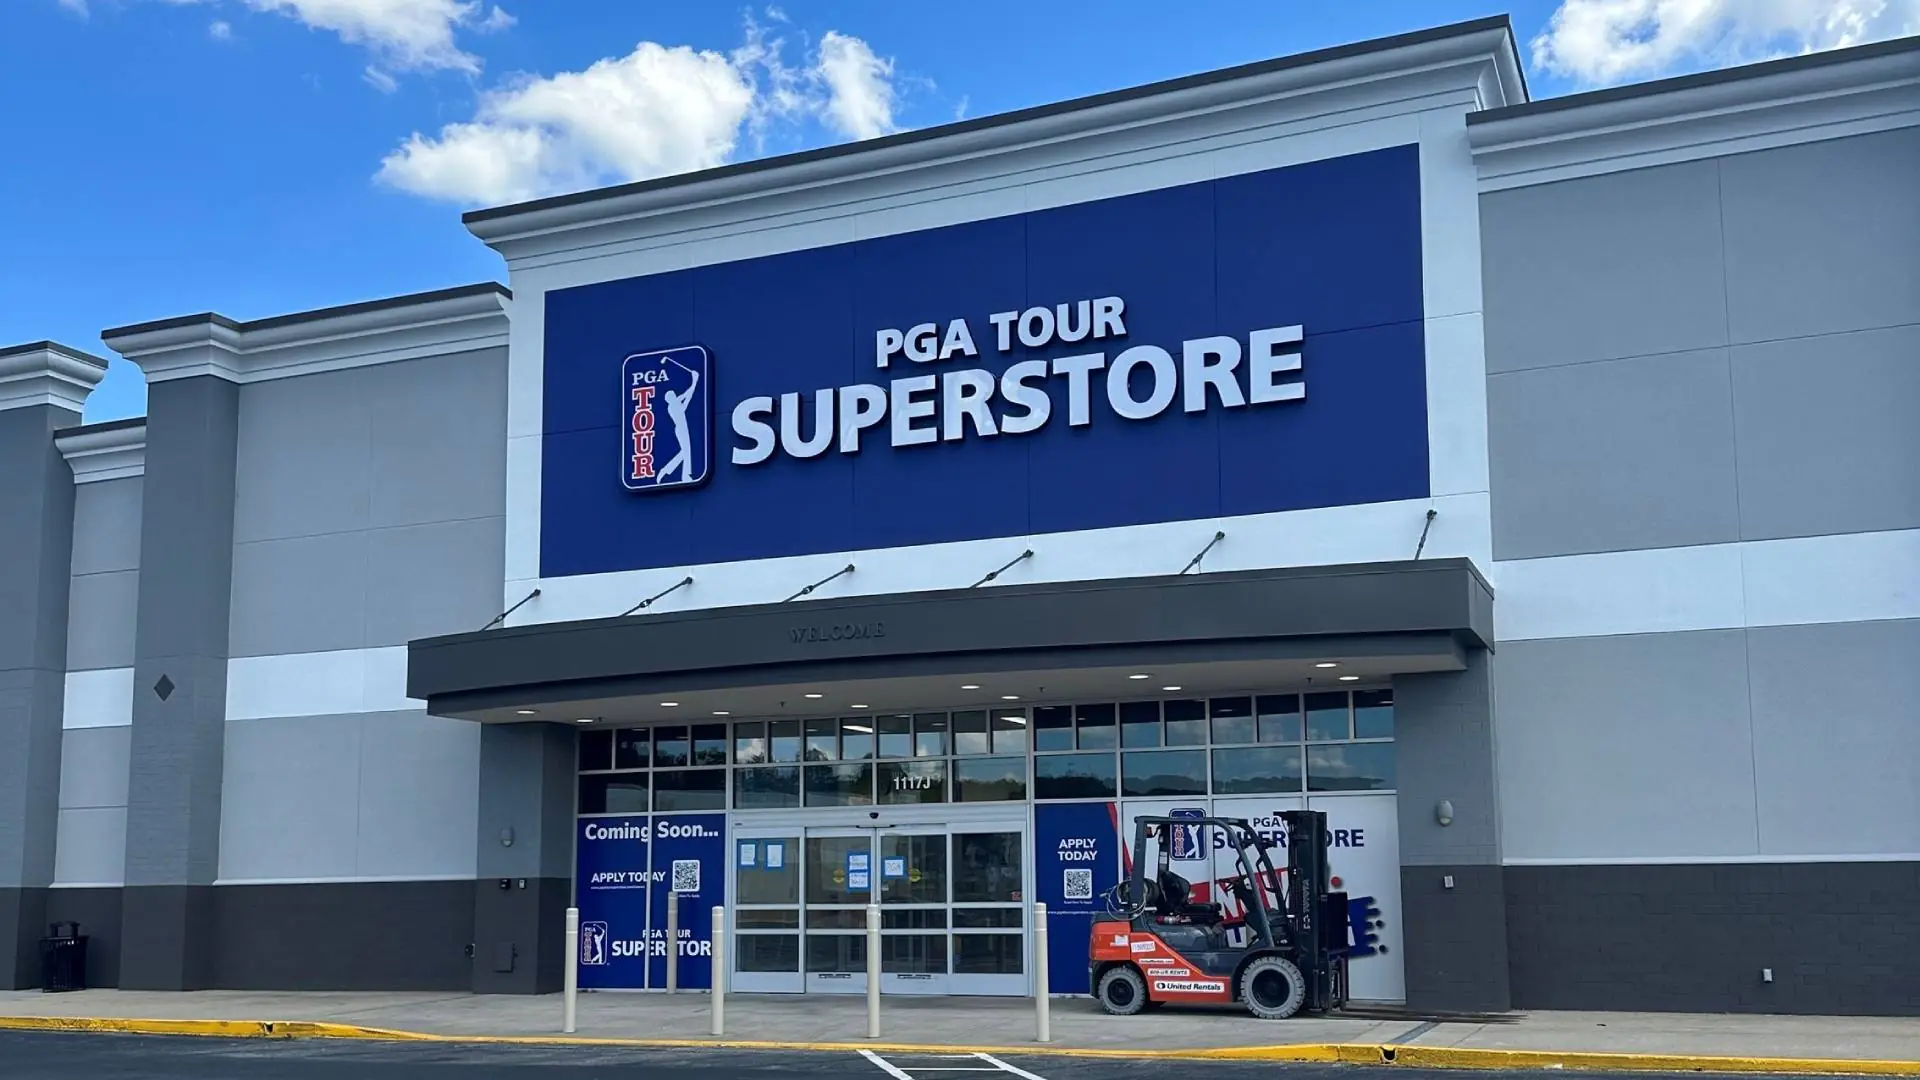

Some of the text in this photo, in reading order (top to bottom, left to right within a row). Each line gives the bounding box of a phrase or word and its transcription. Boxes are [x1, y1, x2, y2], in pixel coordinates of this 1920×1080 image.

[876, 295, 1127, 368] PGA TOUR
[632, 369, 669, 386] PGA
[731, 324, 1307, 466] SUPERSTORE
[631, 386, 655, 479] TOUR
[788, 620, 886, 643] WELCOME
[894, 776, 931, 790] 1117J
[1253, 817, 1281, 828] PGA
[585, 821, 719, 842] Coming Soon...
[1058, 838, 1096, 849] APPLY
[1057, 850, 1098, 861] TODAY
[591, 872, 626, 883] APPLY
[665, 929, 691, 938] TUR
[611, 940, 712, 956] SUPRTOR
[1166, 982, 1221, 991] United Rentals
